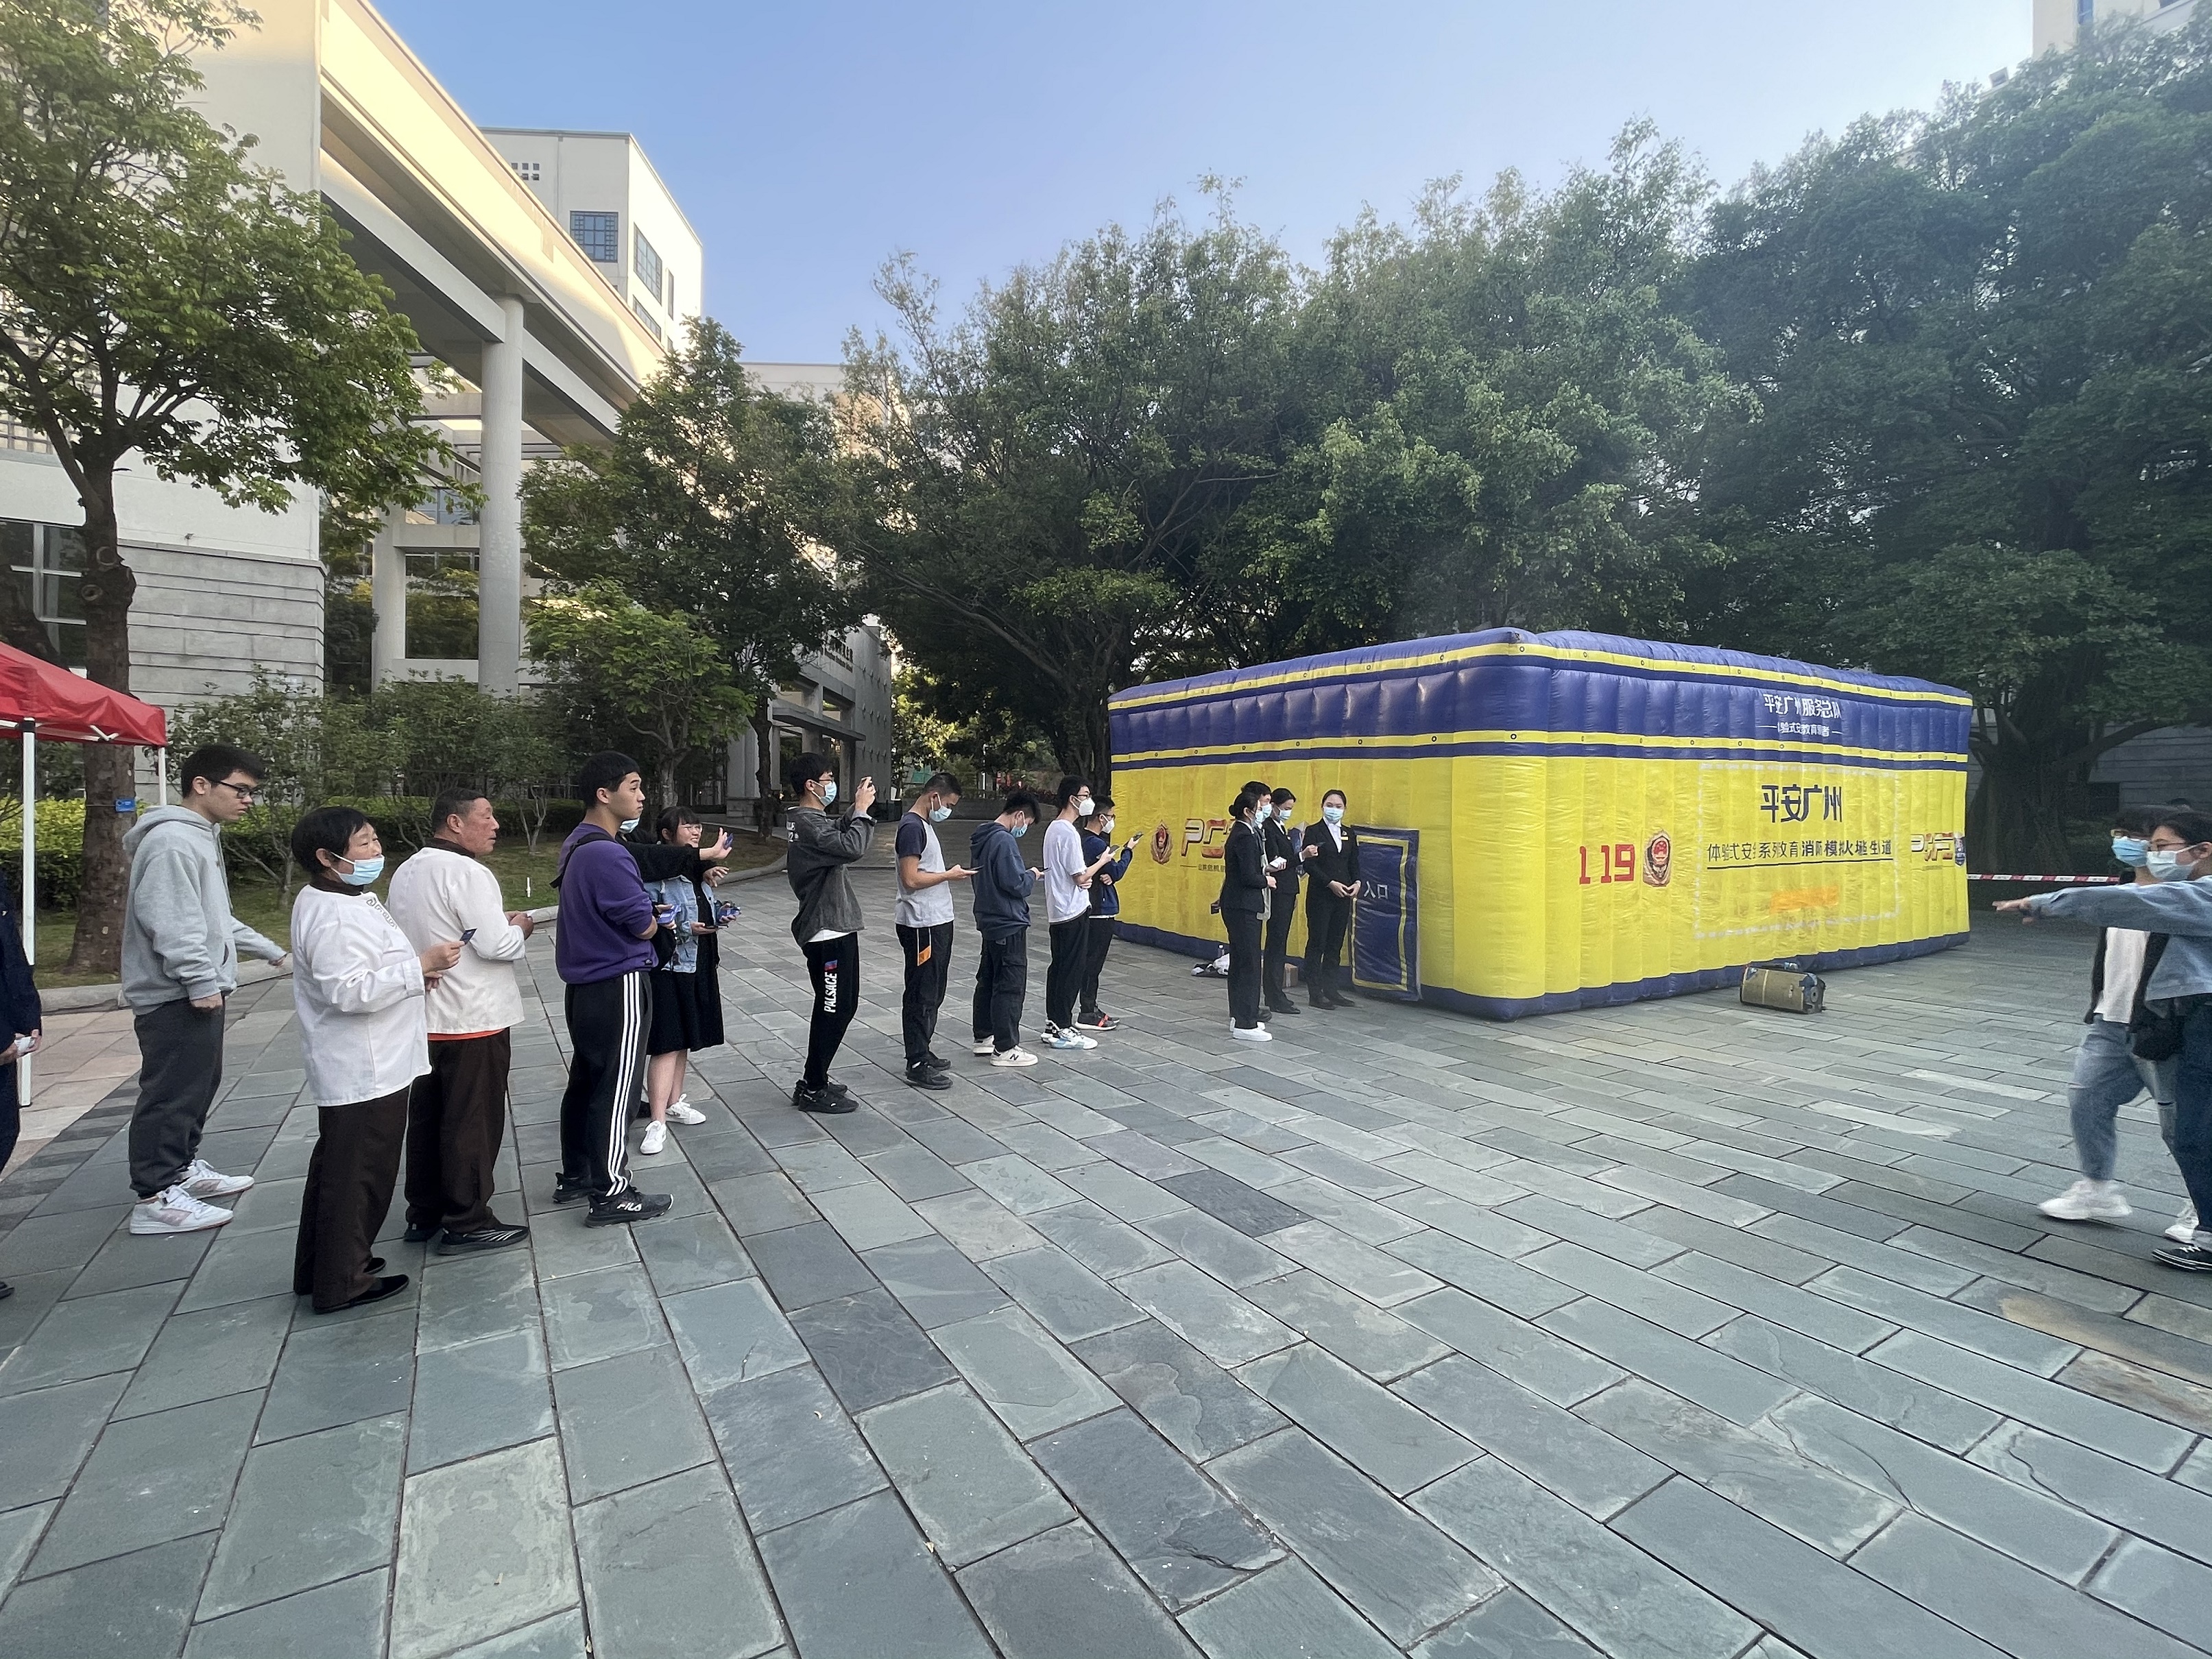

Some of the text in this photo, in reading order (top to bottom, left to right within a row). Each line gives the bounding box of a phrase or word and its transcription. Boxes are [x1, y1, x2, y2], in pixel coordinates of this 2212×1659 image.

[1760, 784, 1842, 823] 平安广州
[1579, 844, 1635, 884] 119
[1363, 881, 1388, 899] 入口
[824, 971, 837, 1013] PALSACE
[616, 1202, 642, 1211] FILA
